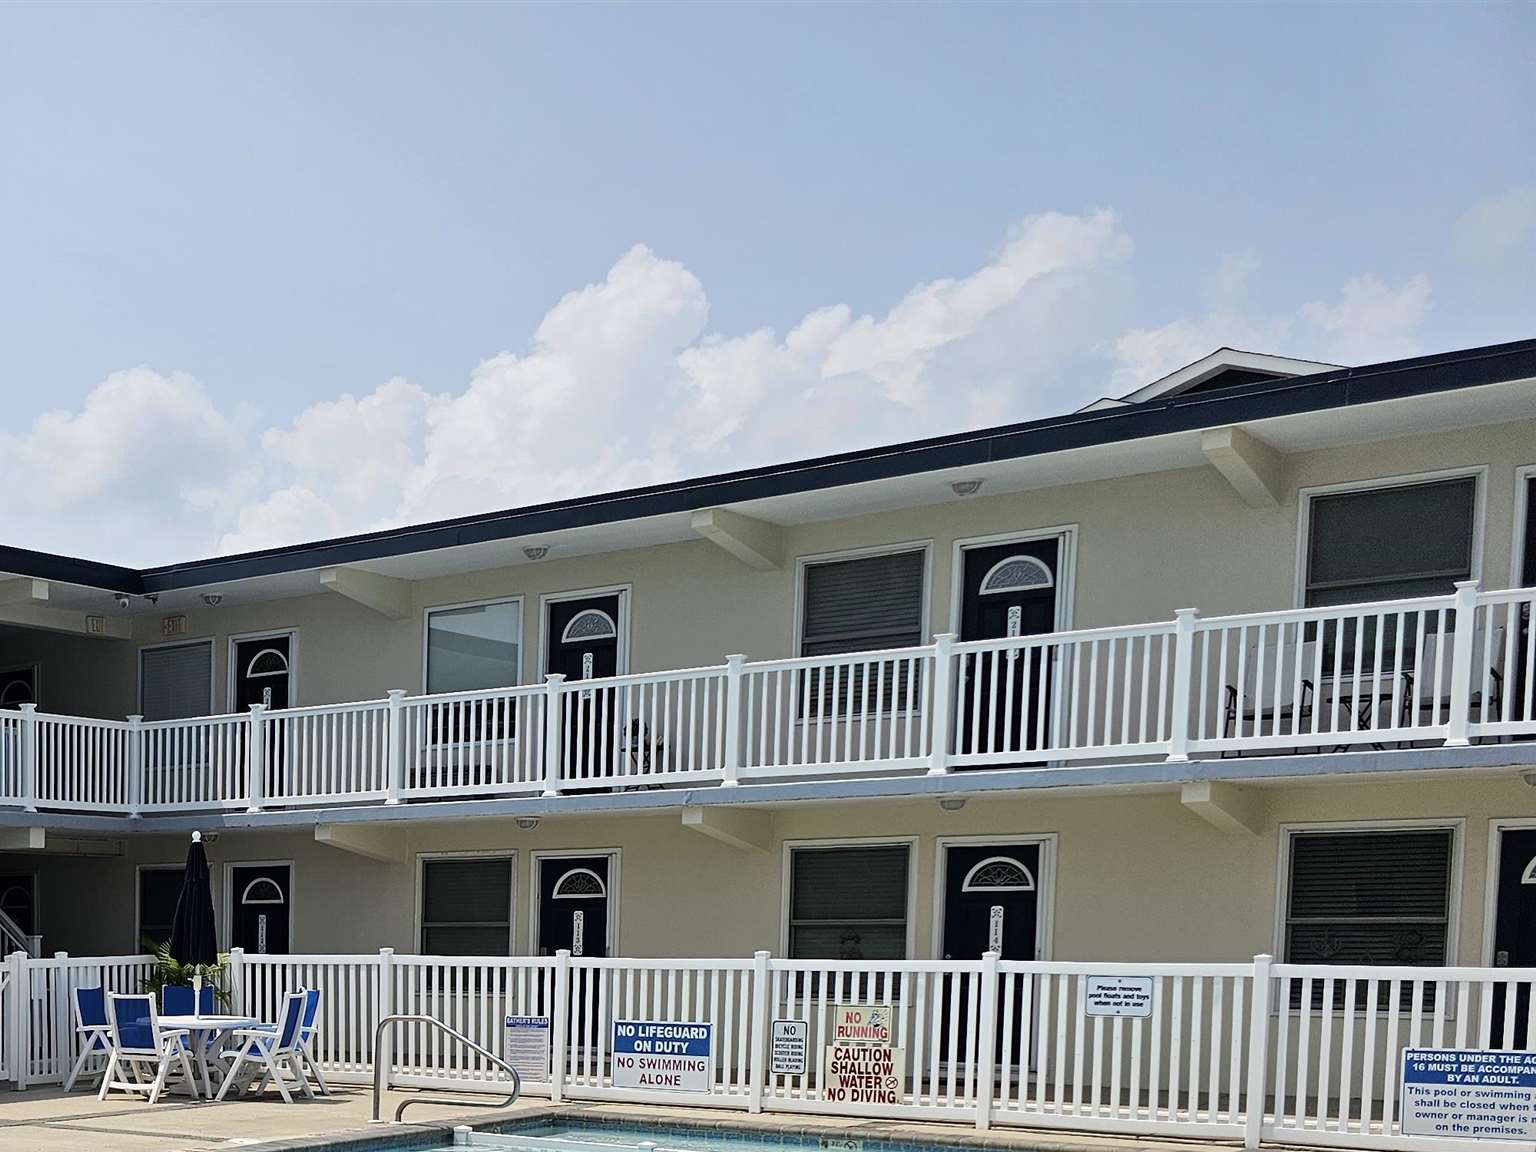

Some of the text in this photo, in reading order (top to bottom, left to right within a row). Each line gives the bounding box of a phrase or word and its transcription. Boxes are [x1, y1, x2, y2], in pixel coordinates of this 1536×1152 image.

[846, 1012, 862, 1024] NO
[617, 1024, 708, 1040] NO LIFEGUARD
[784, 1026, 796, 1036] NO
[838, 1026, 888, 1039] RUNNING
[634, 1040, 690, 1054] ON DUTY
[834, 1047, 892, 1062] CAUTION
[1406, 1052, 1456, 1062] PERSONS
[1459, 1054, 1496, 1063] UNDER
[1498, 1055, 1521, 1064] THE
[617, 1057, 705, 1072] NO SWIMMING
[831, 1061, 894, 1076] SHALLOW
[1412, 1063, 1425, 1072] 16
[1428, 1064, 1458, 1072] MUST
[1460, 1064, 1475, 1072] BE
[639, 1074, 681, 1086] ALONE
[839, 1075, 882, 1090] WATER
[1447, 1074, 1520, 1084] BY AN ADULT.
[828, 1088, 846, 1102] NO
[1407, 1086, 1431, 1096] This
[1434, 1088, 1456, 1098] pool
[1475, 1090, 1531, 1101] swimming
[1414, 1100, 1440, 1108] shall
[1443, 1100, 1457, 1108] be
[1460, 1101, 1496, 1110] closed
[1499, 1102, 1530, 1111] when
[1415, 1112, 1448, 1120] owner
[1466, 1114, 1516, 1124] manager
[1518, 1114, 1528, 1123] is
[1436, 1123, 1527, 1135] on the premises.
